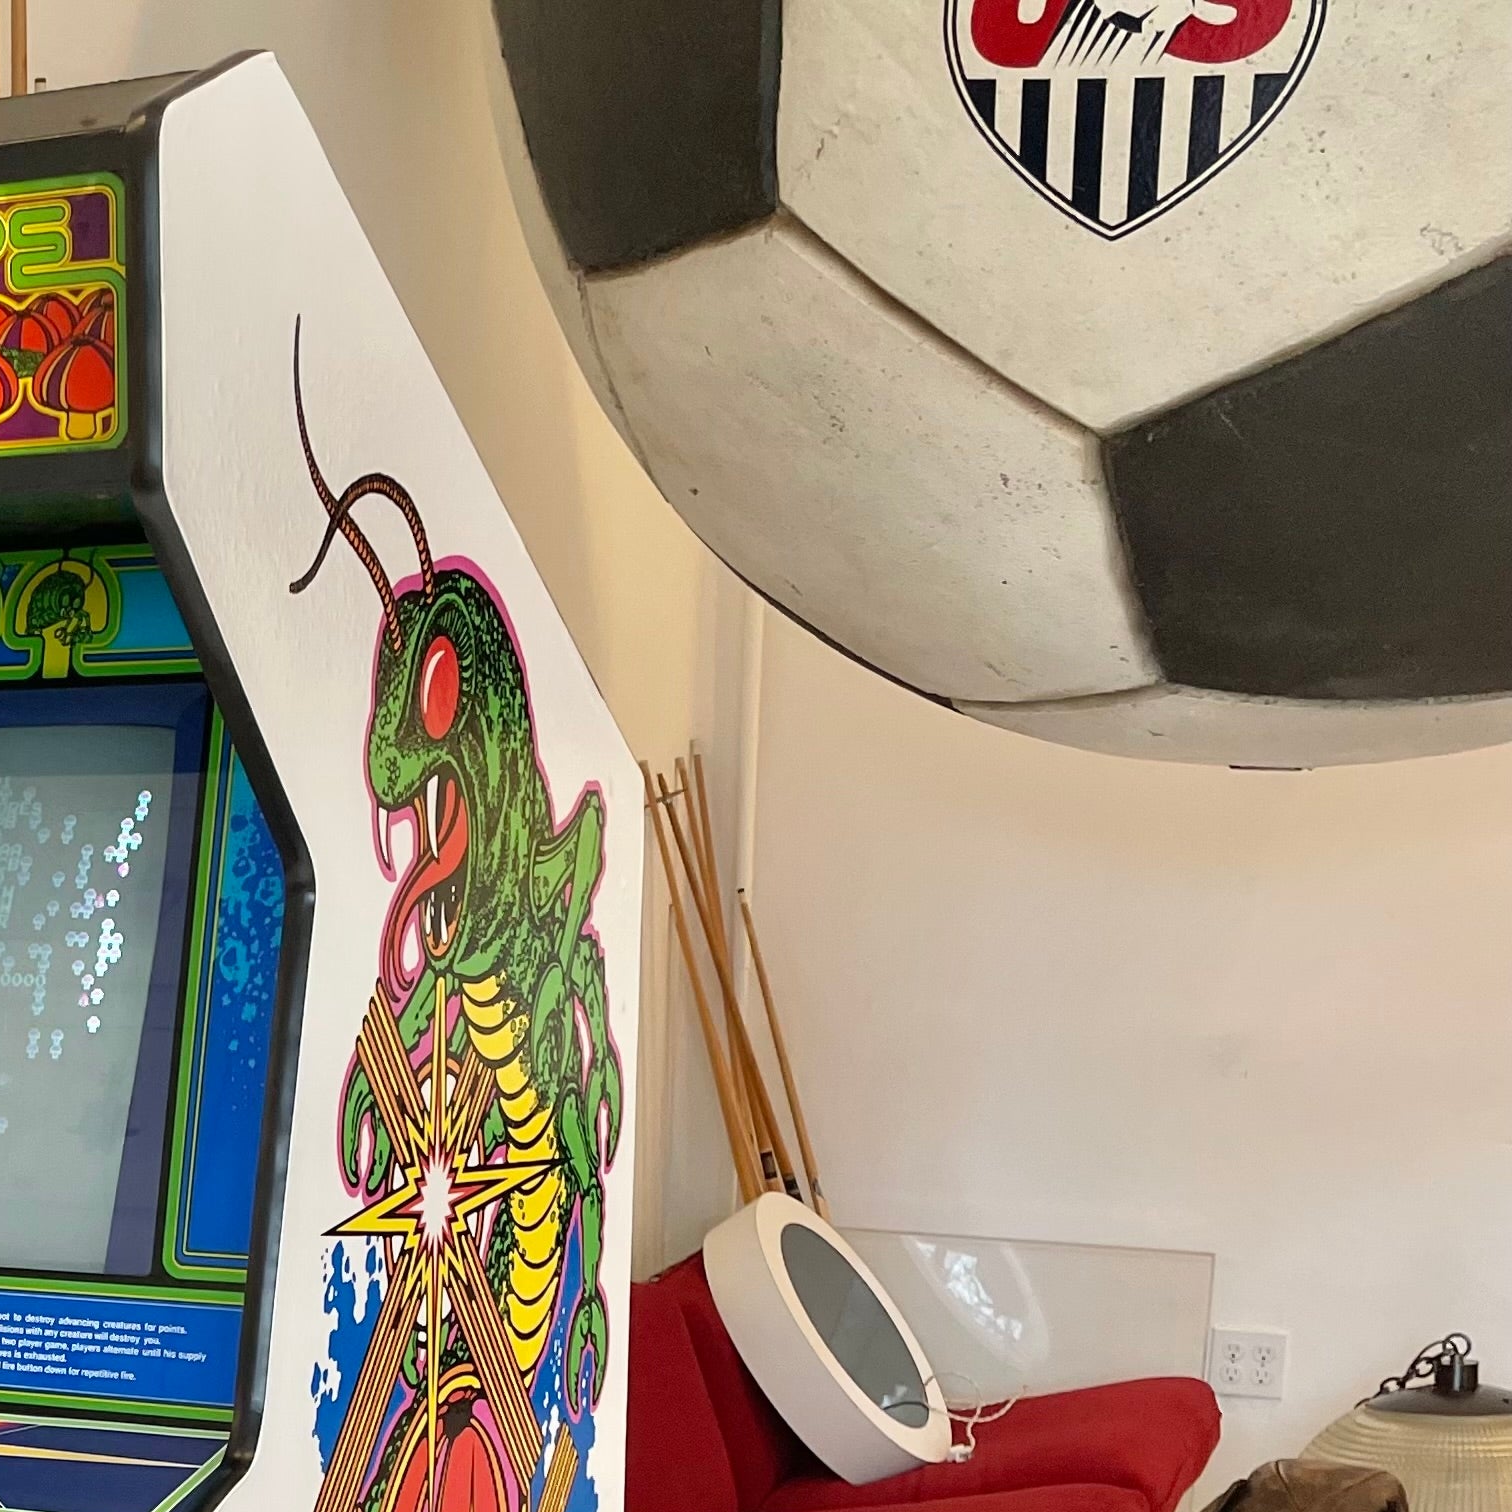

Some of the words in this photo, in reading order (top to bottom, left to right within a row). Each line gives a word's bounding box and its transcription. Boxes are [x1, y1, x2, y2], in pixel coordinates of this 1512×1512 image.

[13, 1312, 22, 1322] to
[24, 1313, 55, 1326] destroy
[58, 1317, 100, 1330] advancing
[102, 1320, 141, 1331] creatures
[144, 1322, 156, 1332] for
[158, 1324, 188, 1335] points.
[25, 1326, 43, 1336] with
[43, 1329, 59, 1339] any
[59, 1329, 93, 1340] creature
[94, 1332, 109, 1341] will
[109, 1333, 141, 1345] destroy
[143, 1337, 161, 1346] you.
[1, 1337, 17, 1346] two
[18, 1338, 43, 1349] player
[71, 1343, 101, 1354] players
[102, 1344, 140, 1356] alternate
[142, 1347, 161, 1357] until
[163, 1349, 177, 1359] his
[178, 1351, 207, 1363] supply
[13, 1349, 22, 1359] is
[23, 1351, 68, 1363] exhausted.
[2, 1361, 16, 1371] fire
[16, 1362, 43, 1373] button
[44, 1365, 67, 1375] down
[68, 1366, 81, 1376] for
[81, 1368, 120, 1380] repetitive
[120, 1370, 137, 1381] fire.
